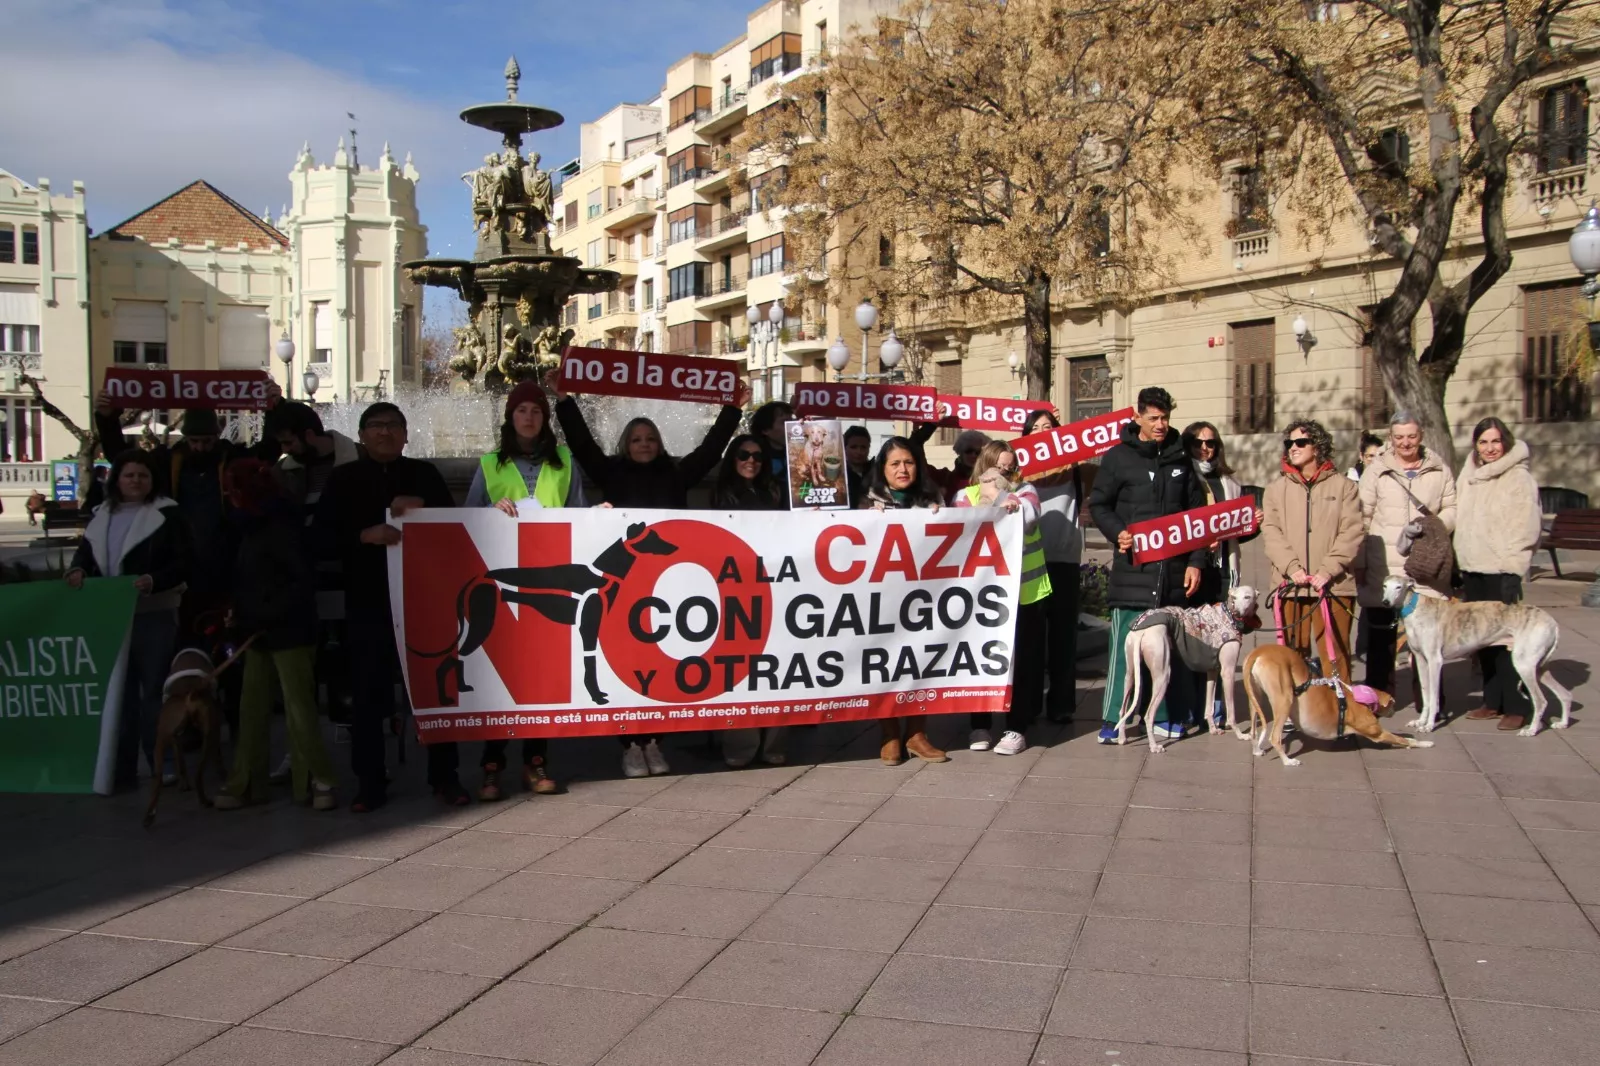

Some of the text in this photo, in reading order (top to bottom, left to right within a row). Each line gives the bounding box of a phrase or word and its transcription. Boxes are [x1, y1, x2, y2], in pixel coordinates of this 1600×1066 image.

[107, 373, 267, 399] no a la caza
[565, 355, 736, 392] no a la caza
[800, 386, 934, 412] no a la caza
[957, 403, 971, 419] a
[976, 399, 997, 421] la
[1034, 442, 1051, 461] a
[1051, 431, 1078, 456] la
[804, 495, 835, 504] CAZA
[1133, 530, 1164, 553] no
[1168, 525, 1182, 545] a
[1184, 514, 1205, 540] la
[1209, 506, 1253, 533] caza
[716, 521, 1010, 585] A LA CAZA
[402, 519, 772, 710] NO
[628, 584, 1010, 644] CON GALGOS
[633, 640, 1010, 696] Y OTRAS RAZAS
[0, 683, 101, 718] BIENTE
[417, 698, 869, 730] uanto más indefensa está una criatura, más derecho tiene a ser defendida
